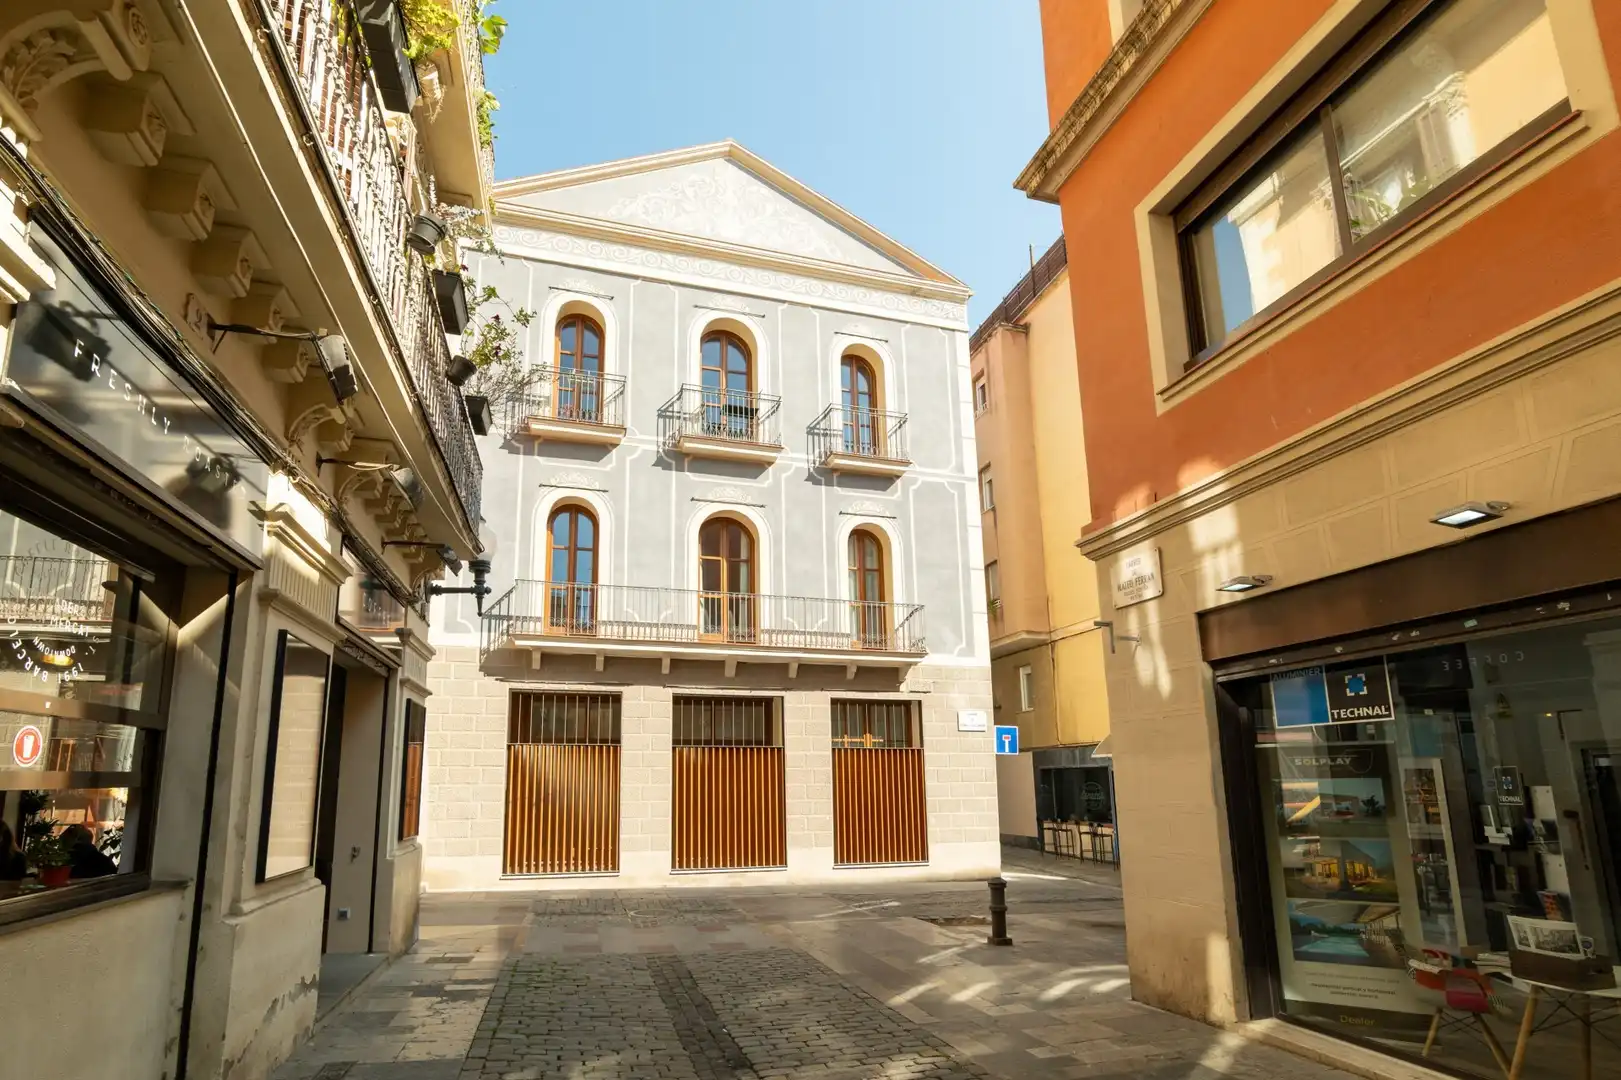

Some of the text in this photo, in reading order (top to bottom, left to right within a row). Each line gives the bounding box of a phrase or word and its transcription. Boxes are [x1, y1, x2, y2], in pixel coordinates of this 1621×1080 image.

[74, 339, 171, 435] FRESHLY
[32, 636, 77, 657] DOWNTOWN
[1331, 705, 1389, 719] TECHNAL
[1294, 757, 1352, 766] SOLPLAY
